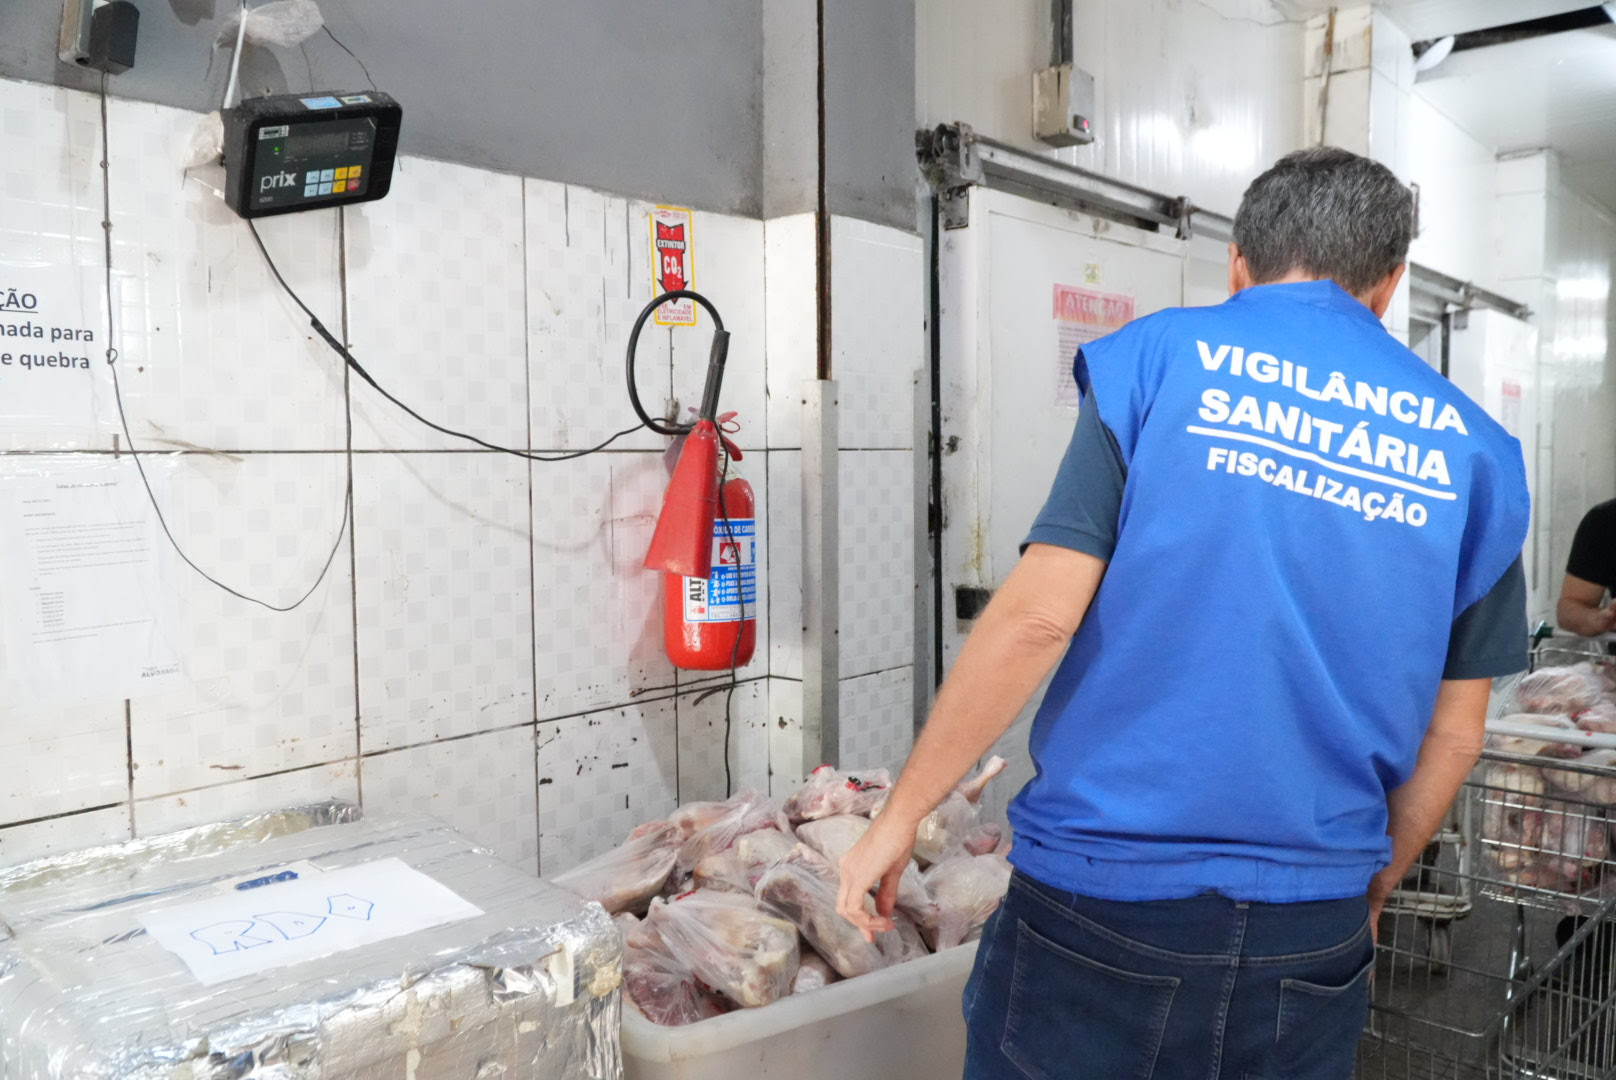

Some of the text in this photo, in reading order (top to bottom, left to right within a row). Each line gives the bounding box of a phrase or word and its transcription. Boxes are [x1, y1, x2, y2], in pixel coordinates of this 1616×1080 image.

[260, 170, 297, 194] prix
[657, 239, 685, 250] EXTINTOR
[51, 327, 94, 343] para
[19, 352, 90, 370] quebra
[1196, 340, 1469, 436] VIGILÂNCIA
[1198, 388, 1451, 485] SANITÁRIA
[1206, 447, 1428, 527] FISCALIZAÇÃO
